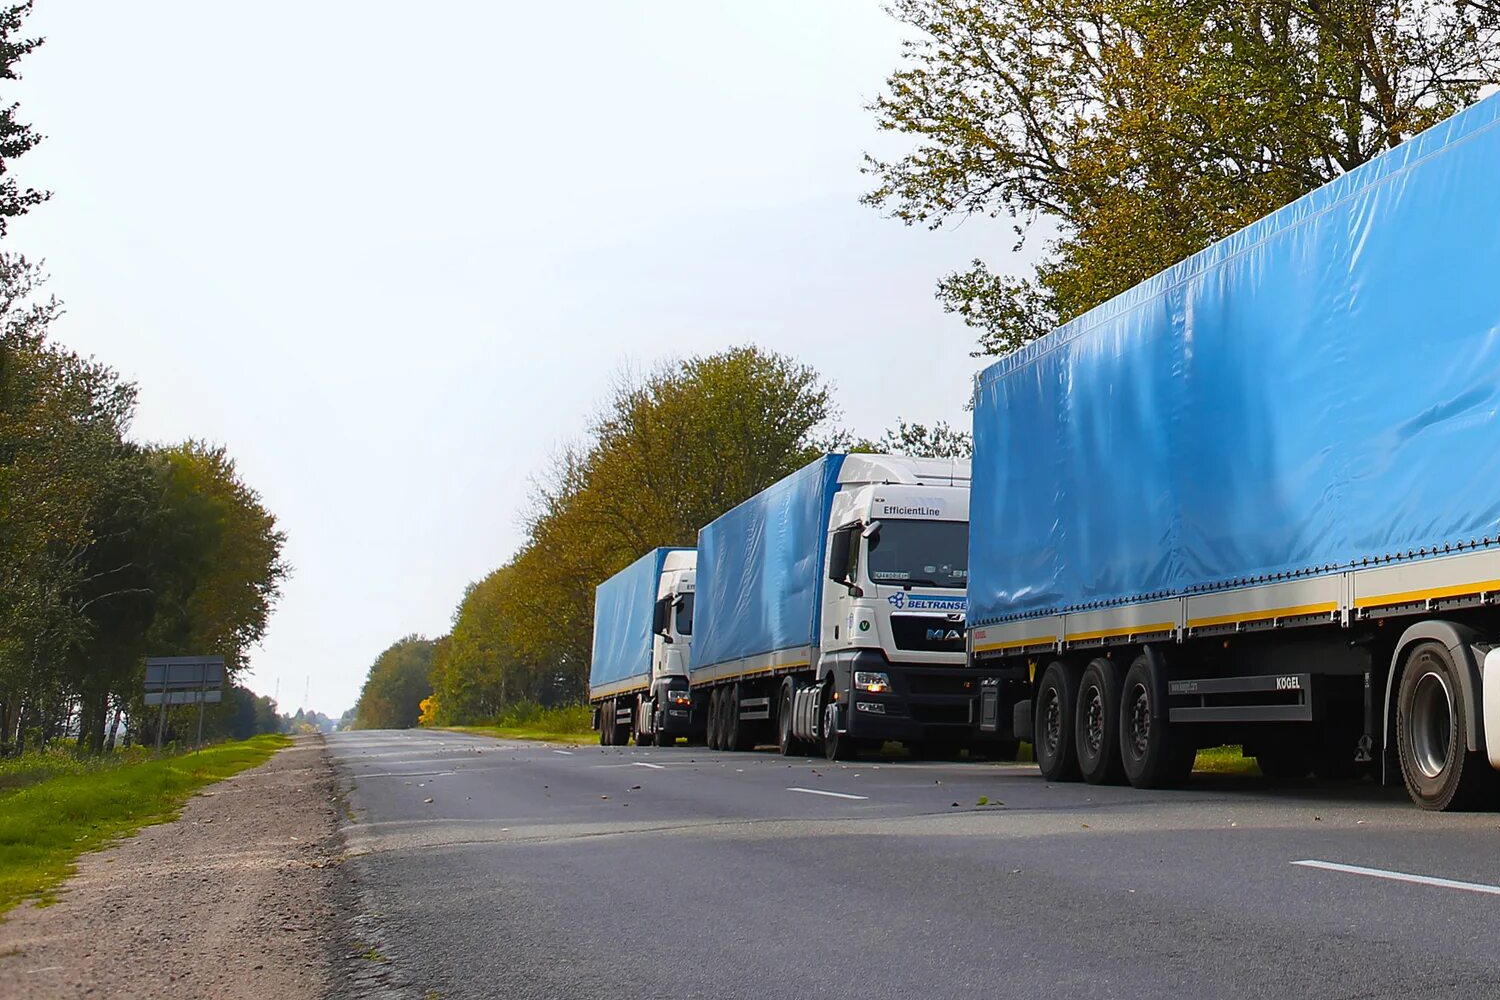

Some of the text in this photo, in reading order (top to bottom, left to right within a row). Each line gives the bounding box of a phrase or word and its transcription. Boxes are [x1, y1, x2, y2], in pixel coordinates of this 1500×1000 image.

[883, 506, 940, 516] EfficientLine
[927, 629, 967, 640] MA
[1276, 676, 1301, 690] KÖGEL
